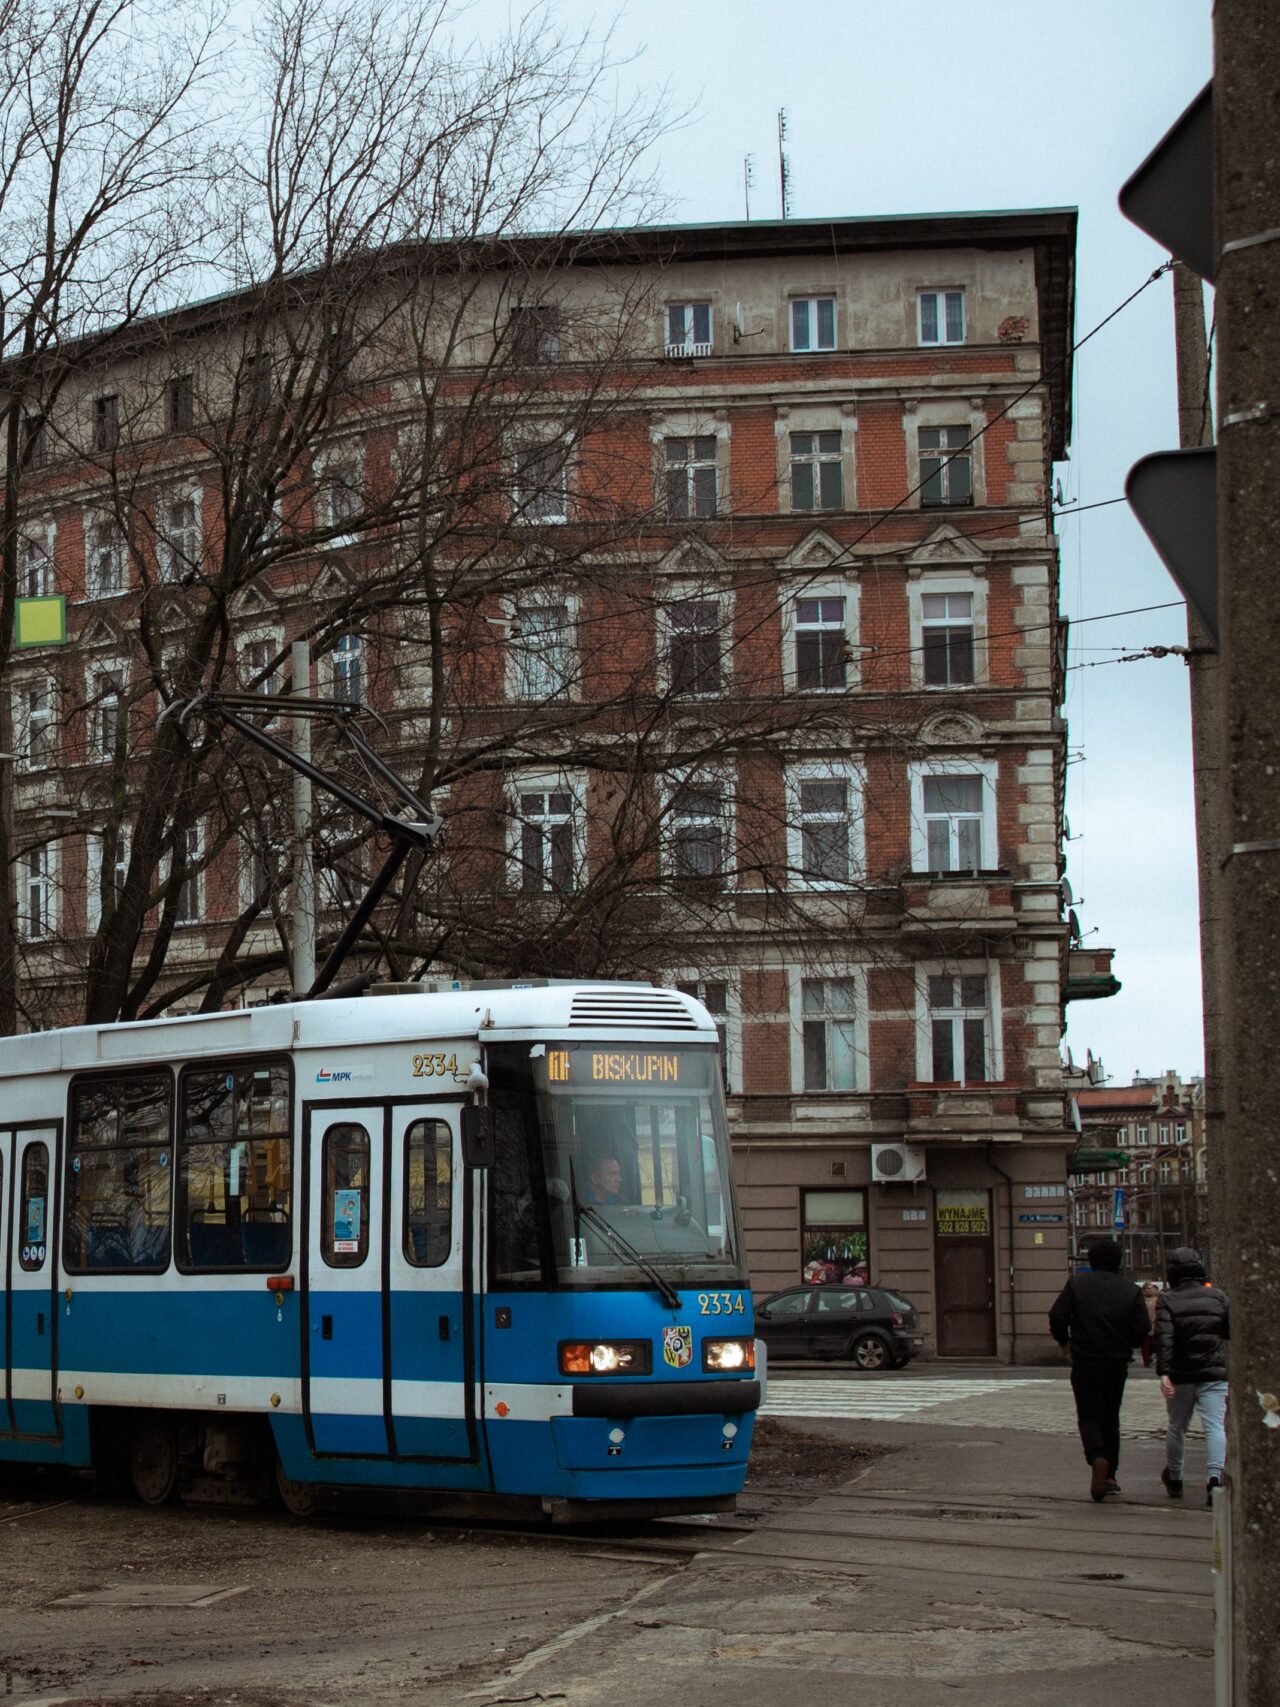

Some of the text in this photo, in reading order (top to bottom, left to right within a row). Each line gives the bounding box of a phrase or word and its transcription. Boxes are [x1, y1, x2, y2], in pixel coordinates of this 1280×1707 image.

[412, 1053, 458, 1077] 2334
[592, 1053, 678, 1081] BISKUPIN
[331, 1071, 352, 1082] MPK
[939, 1221, 986, 1232] 502 828 902
[698, 1293, 744, 1315] 2334
[665, 1348, 677, 1363] W
